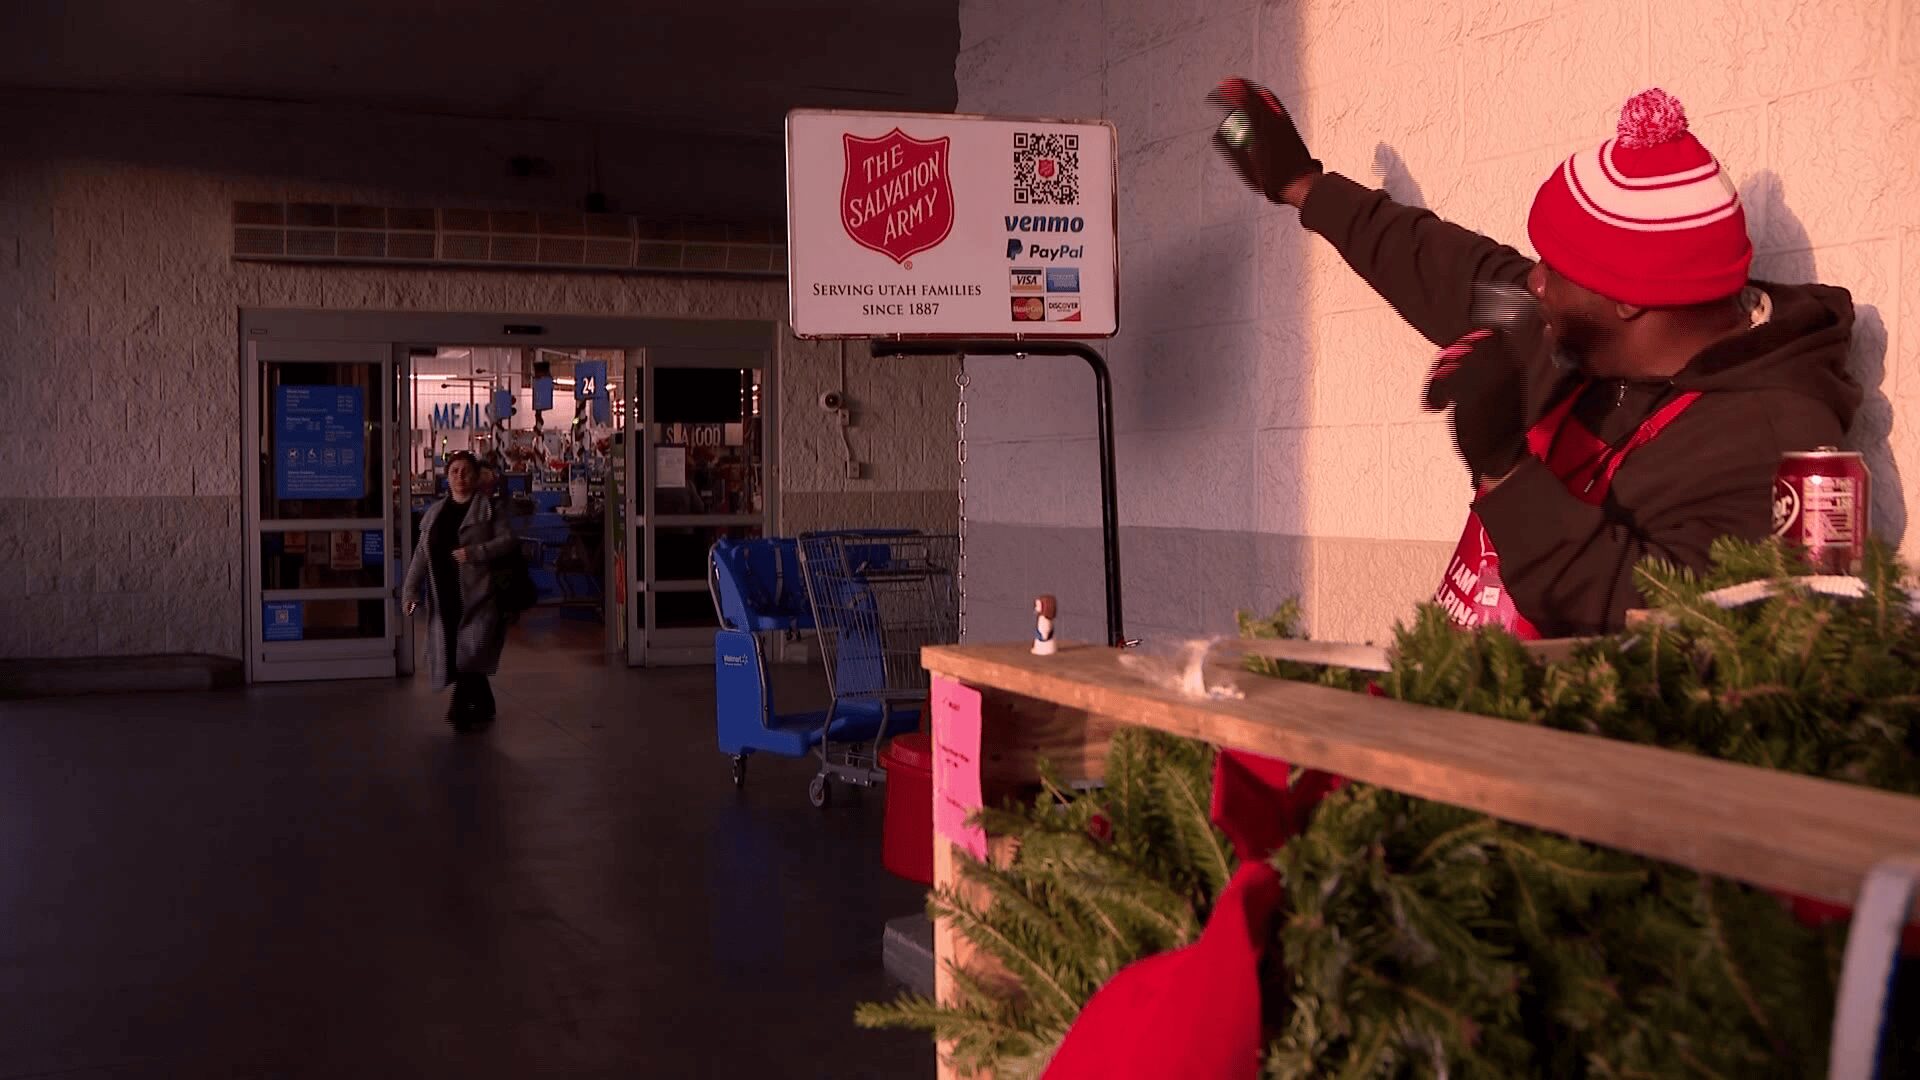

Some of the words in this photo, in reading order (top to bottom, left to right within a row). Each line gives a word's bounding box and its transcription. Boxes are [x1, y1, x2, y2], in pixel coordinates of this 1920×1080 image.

[863, 144, 904, 184] THE
[850, 151, 940, 228] SALVATION
[883, 188, 938, 246] ARMY
[1005, 215, 1084, 233] venmo
[1029, 244, 1084, 261] PayPal
[813, 283, 873, 296] SERVING
[878, 284, 916, 296] UTAH
[922, 284, 982, 296] FAMILIES
[1017, 275, 1037, 285] VISA
[863, 304, 904, 316] SINCE
[909, 303, 939, 316] 1887
[582, 376, 595, 394] 24
[666, 426, 721, 447] SAOOD
[1448, 555, 1461, 576] I
[1451, 562, 1479, 596] AM
